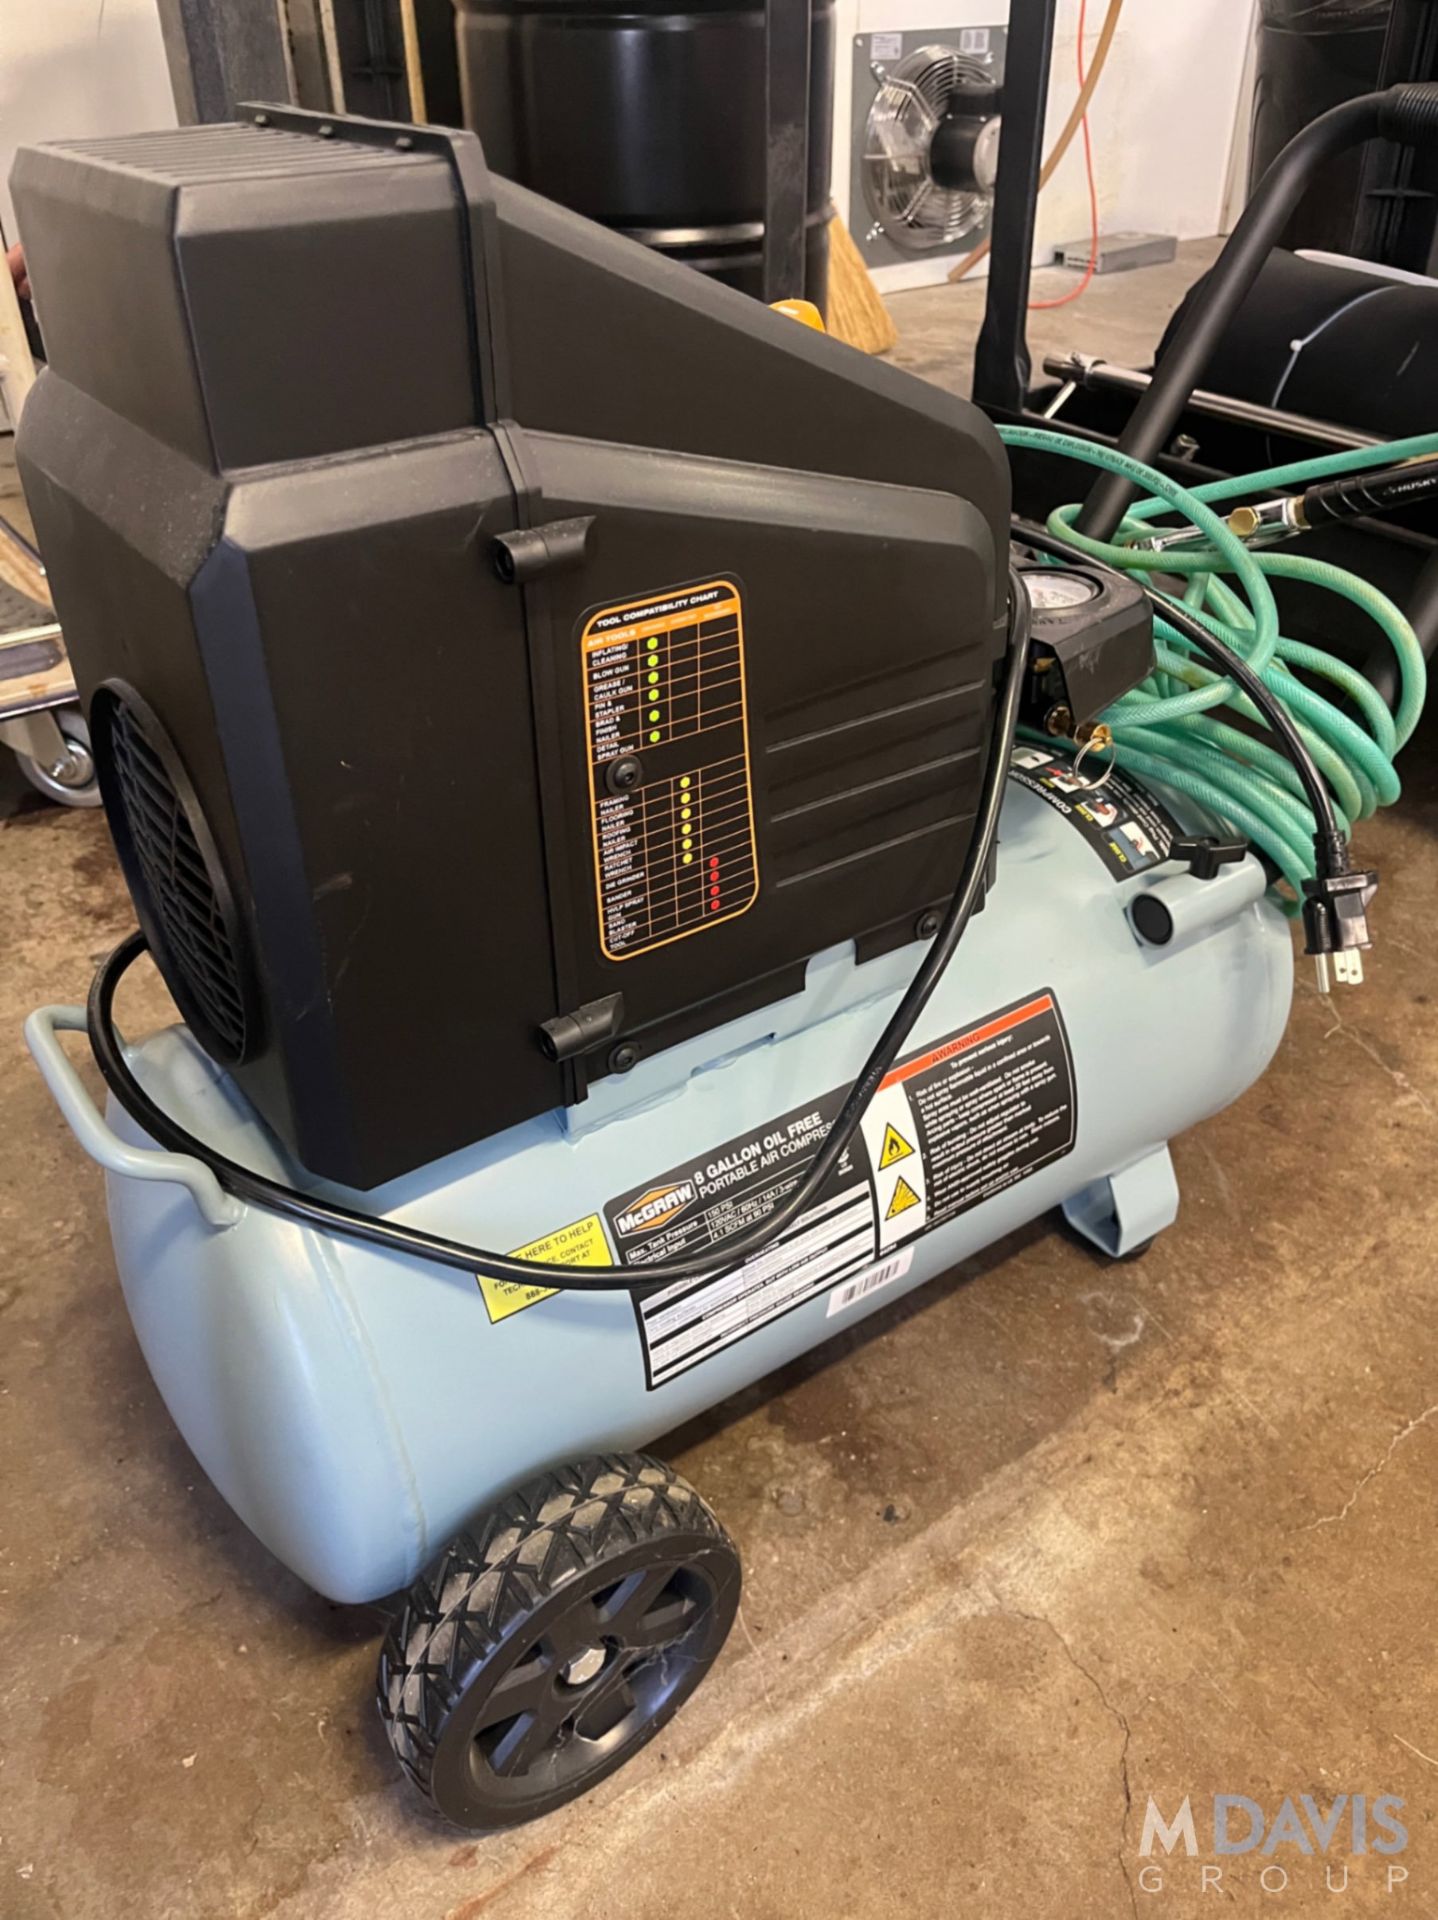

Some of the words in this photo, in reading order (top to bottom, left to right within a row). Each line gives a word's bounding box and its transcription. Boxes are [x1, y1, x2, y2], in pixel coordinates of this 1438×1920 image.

[596, 614, 622, 629] TOOL
[622, 598, 689, 622] COMPATIBILITY
[689, 590, 719, 605] CHART
[587, 637, 604, 648] AIR
[606, 629, 637, 643] TOOLS
[592, 652, 627, 667] CLEANING
[593, 669, 614, 680] BLOW
[614, 664, 630, 675] GUN
[593, 679, 621, 693] GREASE
[594, 690, 617, 701] CAULK
[618, 684, 634, 695] GUN
[595, 702, 606, 710] PIN
[595, 704, 625, 719] STAPLER
[595, 717, 614, 728] BRAD
[596, 731, 620, 744] NAILER
[597, 741, 619, 753] DETAIL
[619, 744, 635, 754] GUN
[600, 794, 630, 808] FRAMING
[600, 803, 624, 817] NAILER
[601, 809, 634, 825] FLOORING
[601, 819, 625, 832] NAILER
[602, 826, 631, 840] ROOFING
[602, 835, 626, 848] NAILER
[603, 847, 615, 857] AIR
[614, 839, 638, 853] IMPACT
[603, 849, 632, 863] WRENCH
[604, 856, 633, 871] RATCHET
[604, 864, 632, 878] WRENCH
[605, 881, 616, 890] DIE
[616, 871, 645, 886] GRINDER
[606, 889, 632, 904] SANDER
[608, 919, 626, 930] SAND
[608, 921, 637, 936] BLASTER
[609, 940, 626, 951] TOOL
[938, 1032, 979, 1059] WARNING
[694, 1171, 705, 1185] 8
[706, 1142, 762, 1179] GALLON
[763, 1131, 787, 1150] OIL
[787, 1112, 823, 1138] FREE
[699, 1160, 759, 1199] PORTABLE
[760, 1151, 780, 1168] AIR
[780, 1118, 836, 1157] COMPRES
[617, 1183, 692, 1233] McGRAW
[629, 1247, 647, 1260] Max.
[647, 1236, 666, 1250] Tank
[665, 1220, 698, 1241] Pressure
[720, 1201, 733, 1212] PSI
[525, 1240, 553, 1259] HERE
[553, 1234, 567, 1246] TO
[569, 1221, 593, 1240] HELP
[666, 1238, 687, 1252] Input
[560, 1238, 593, 1259] CONTACT
[582, 1250, 591, 1259] AT
